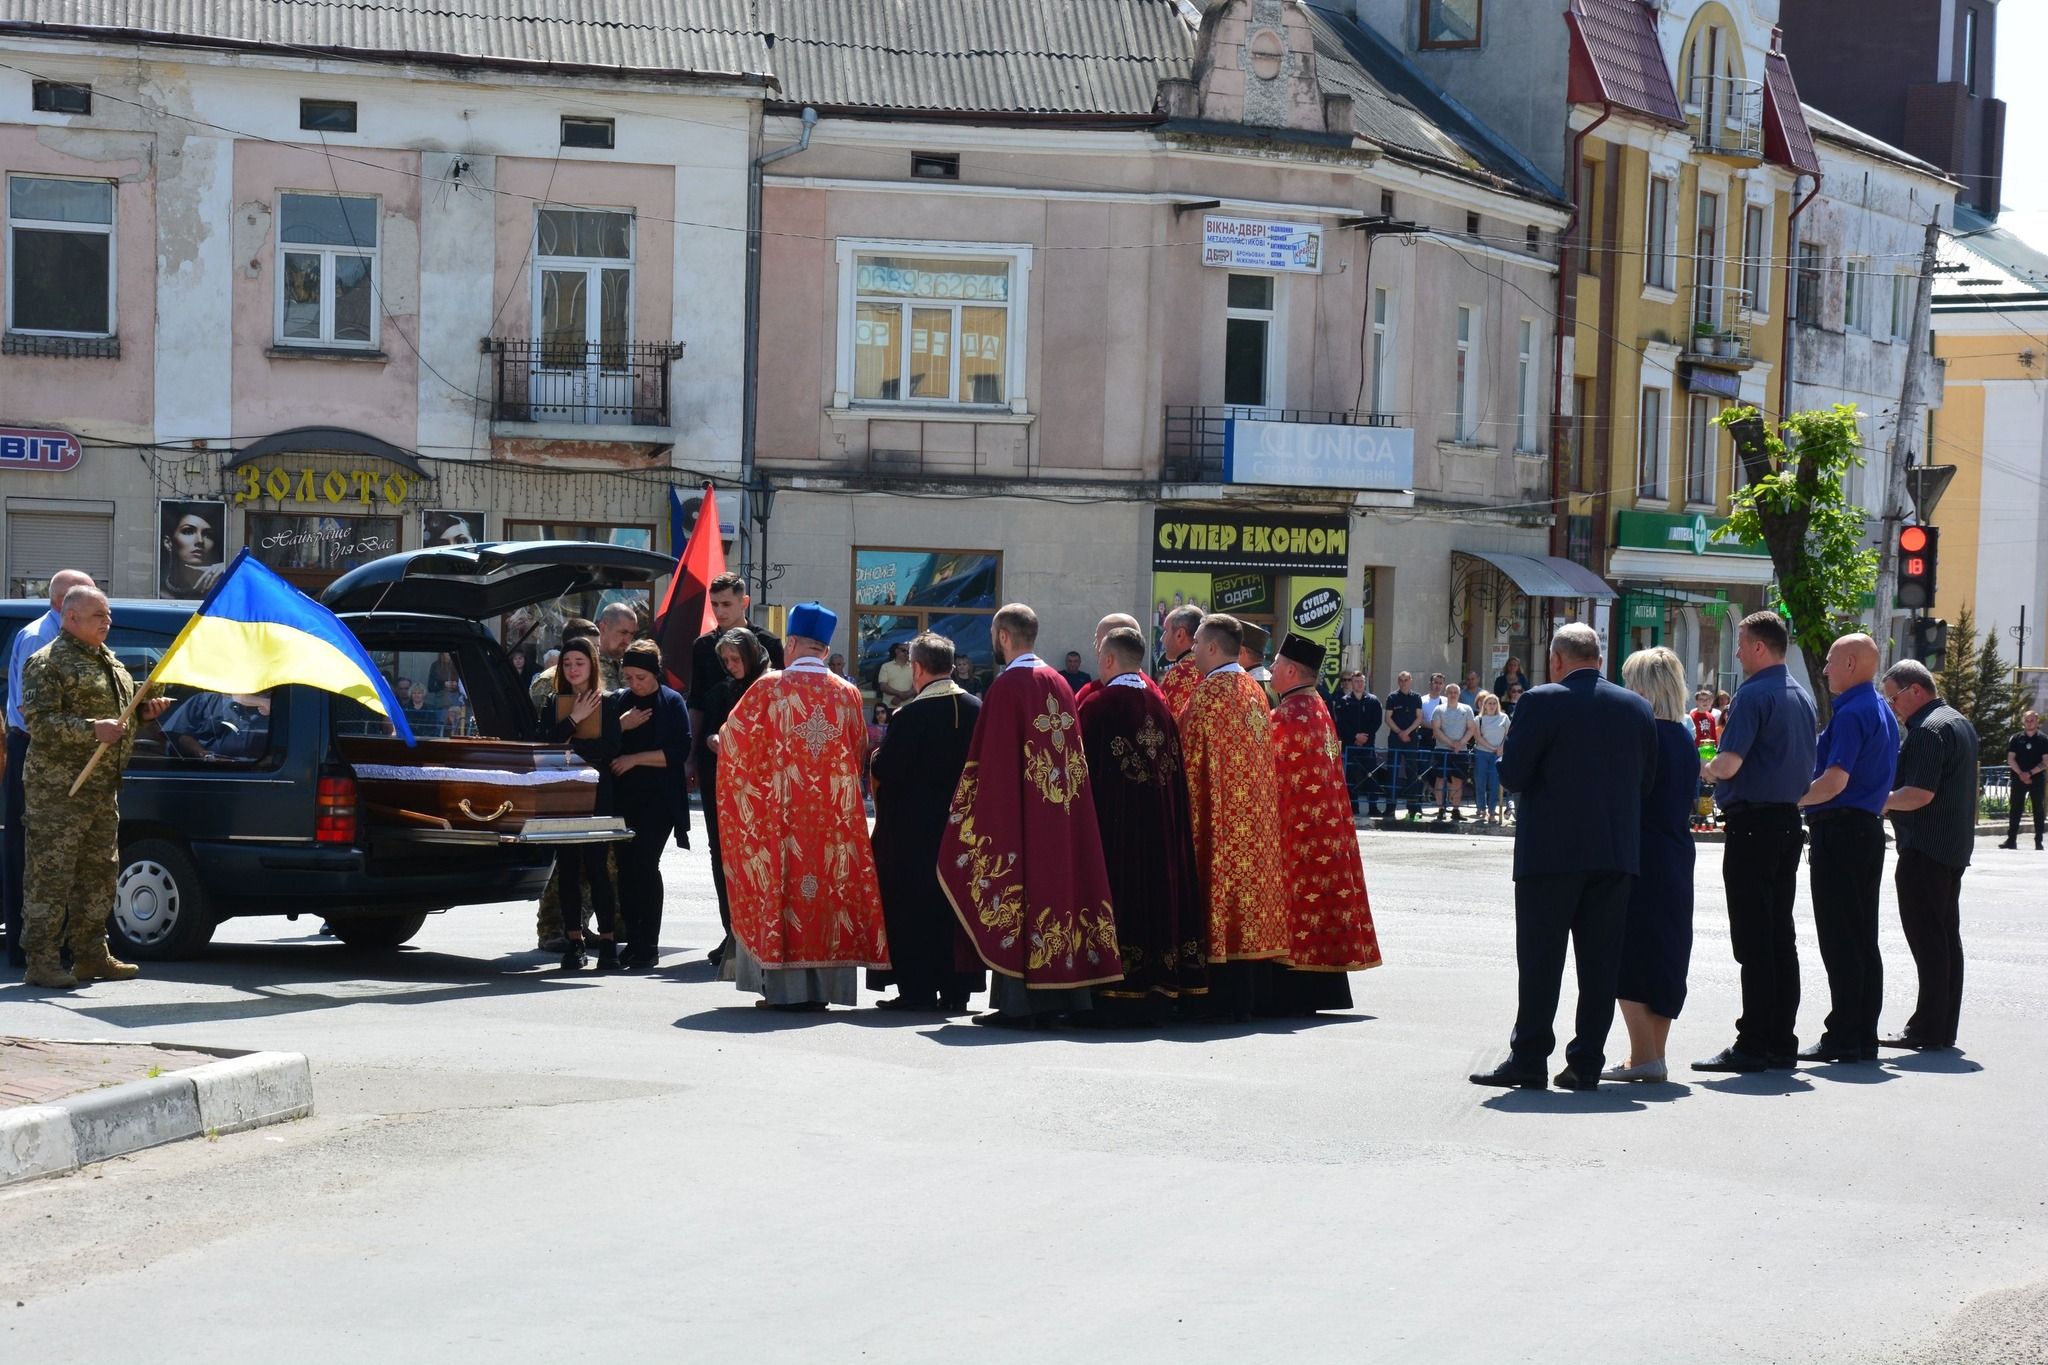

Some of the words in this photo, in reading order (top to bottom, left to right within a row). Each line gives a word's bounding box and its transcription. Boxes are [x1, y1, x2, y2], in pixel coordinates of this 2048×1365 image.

[1304, 431, 1396, 464] UNIQA
[235, 464, 408, 505] ЗОЛОТО
[330, 541, 355, 561] для
[356, 536, 394, 552] Вас
[1158, 522, 1238, 551] СУПЕР
[1242, 526, 1347, 555] ЕКОНОМ
[1908, 558, 1923, 575] 18
[1214, 575, 1261, 592] ВЗУТТЯ
[1224, 586, 1257, 604] ОДЯГ
[1302, 591, 1330, 611] СУПЕР
[1299, 600, 1338, 625] ЕКОНОМ
[1634, 605, 1657, 618] АПТЕКА
